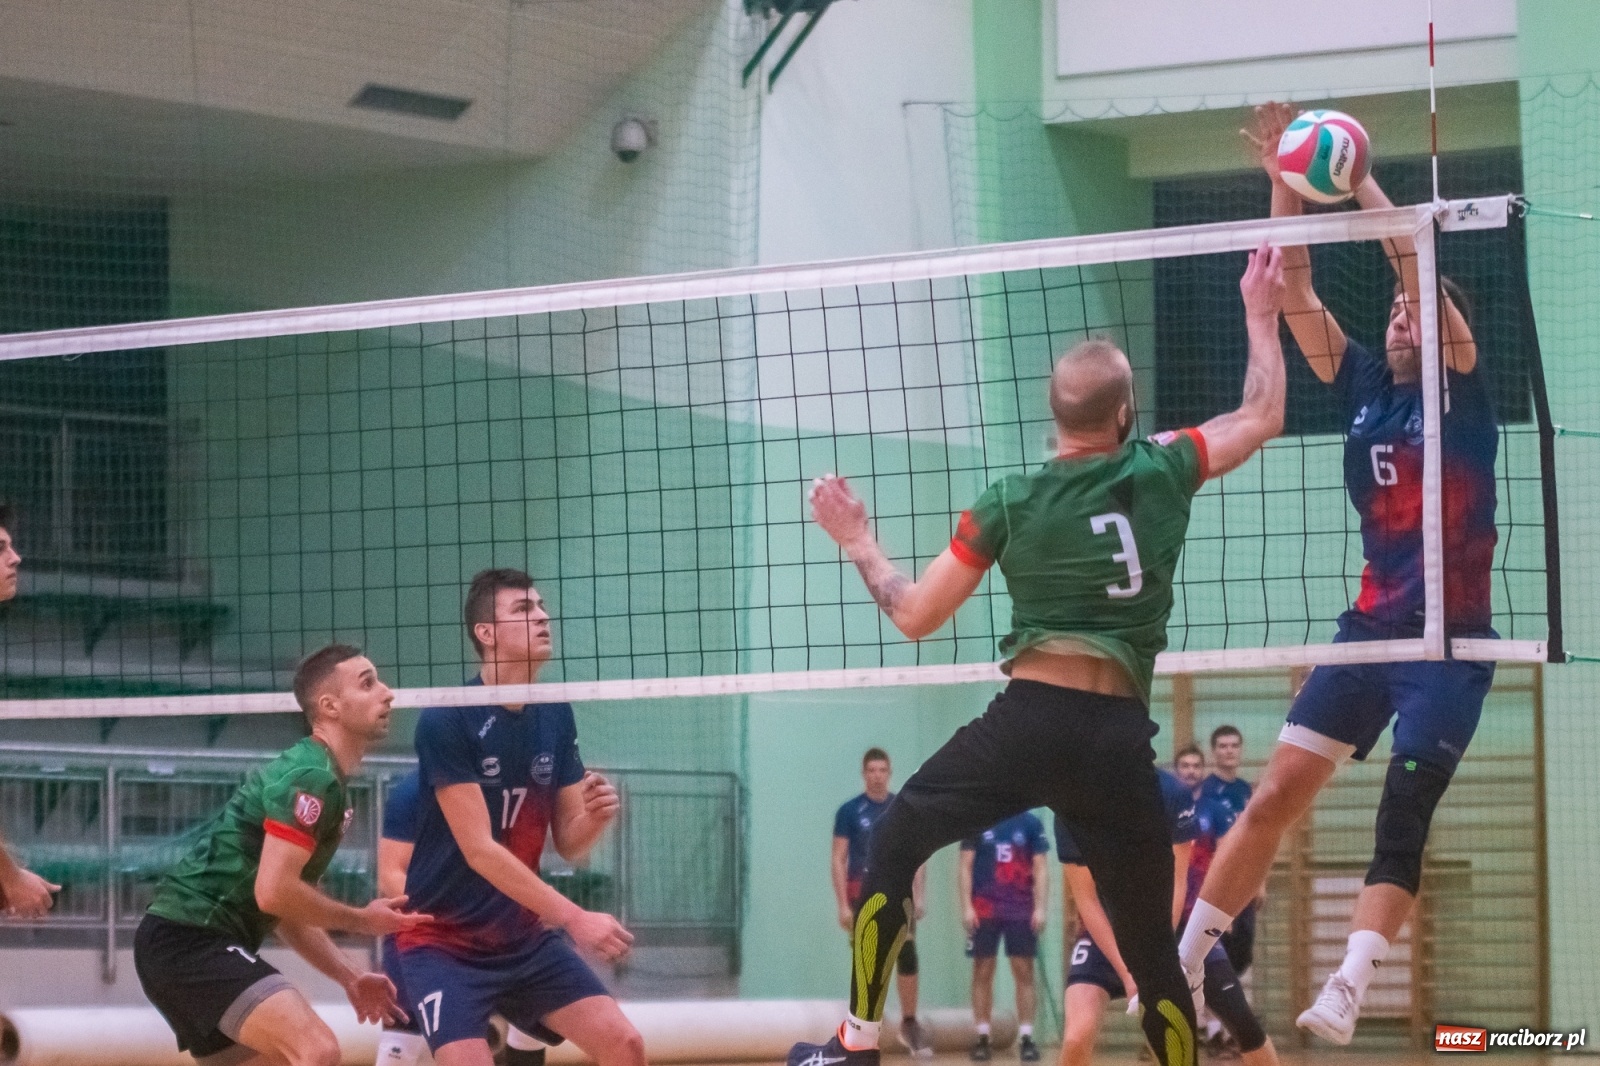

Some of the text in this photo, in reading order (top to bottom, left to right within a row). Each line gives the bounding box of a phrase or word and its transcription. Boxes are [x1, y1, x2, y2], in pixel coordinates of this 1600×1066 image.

[1333, 136, 1350, 177] molten
[1370, 444, 1398, 486] 6
[1089, 512, 1143, 598] 3
[501, 787, 528, 830] 17
[995, 843, 1013, 863] 15
[1071, 940, 1092, 966] 6
[417, 990, 443, 1037] 17
